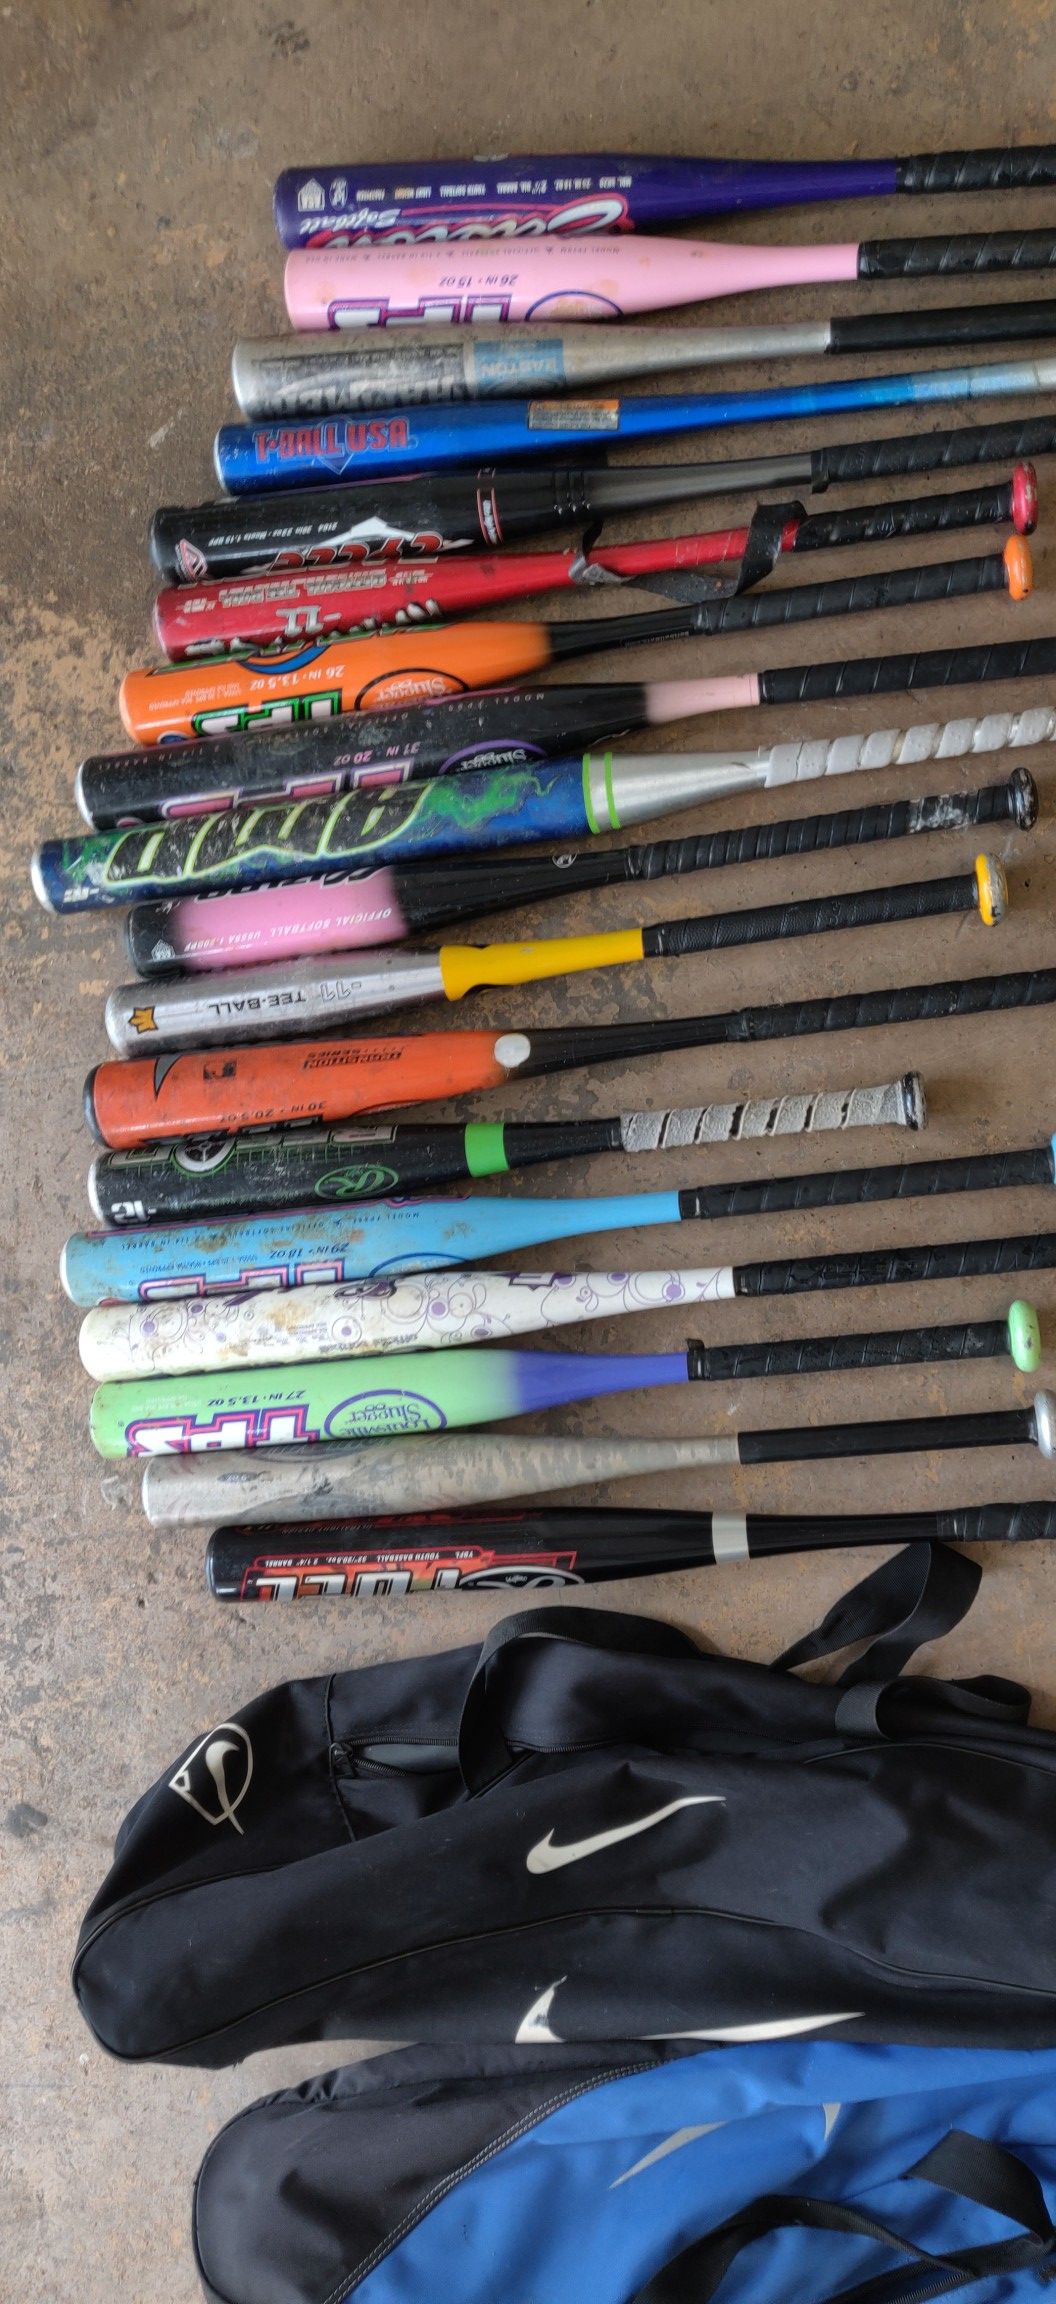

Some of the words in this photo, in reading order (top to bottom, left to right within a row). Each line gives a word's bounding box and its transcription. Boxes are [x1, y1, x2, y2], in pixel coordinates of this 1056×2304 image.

[299, 208, 401, 236] Softball
[458, 275, 473, 288] 15
[486, 275, 499, 286] IN
[500, 274, 519, 287] 26
[346, 416, 410, 453] USA
[275, 605, 341, 638] -11
[308, 668, 322, 680] IN
[326, 664, 345, 679] 26
[249, 679, 264, 691] OZ
[377, 678, 447, 703] Slugger
[385, 744, 400, 757] IN
[404, 740, 421, 756] 31
[332, 754, 351, 766] OZ
[354, 749, 373, 764] 20
[459, 748, 528, 772] Slugger
[335, 907, 392, 926] OFFICIAL
[269, 917, 331, 937] SOFTBALL
[314, 1244, 329, 1255] IN
[331, 1240, 350, 1254] 29
[229, 1394, 259, 1407] 13.5
[268, 1391, 283, 1402] IN
[286, 1389, 306, 1401] 27
[206, 1397, 225, 1408] OZ
[349, 1402, 422, 1425] Slugger
[124, 1403, 320, 1457] TPS
[376, 1553, 414, 1563] BASEBALL
[415, 1551, 440, 1561] YOUTH
